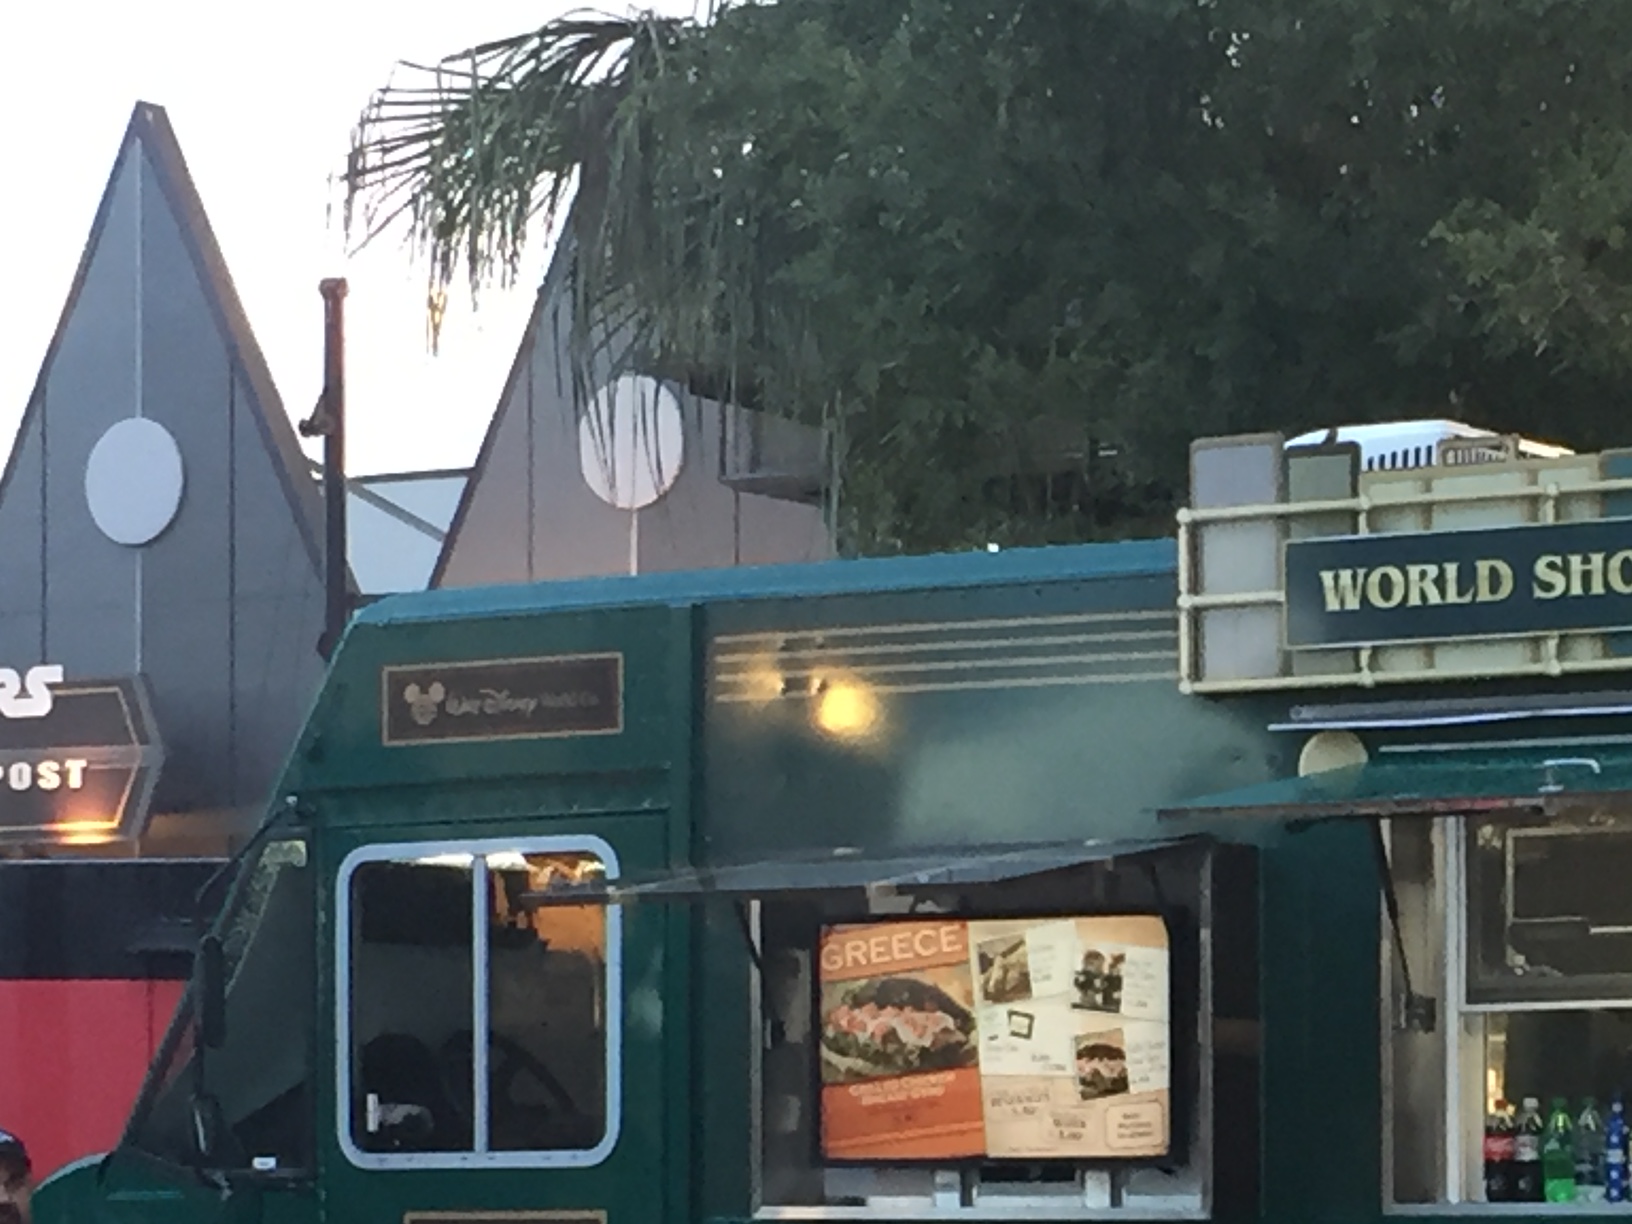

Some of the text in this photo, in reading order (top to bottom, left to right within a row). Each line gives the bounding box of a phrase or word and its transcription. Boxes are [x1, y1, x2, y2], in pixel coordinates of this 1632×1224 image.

[1319, 558, 1515, 613] WORLD
[0, 759, 88, 791] OST
[821, 923, 964, 972] GREECE
